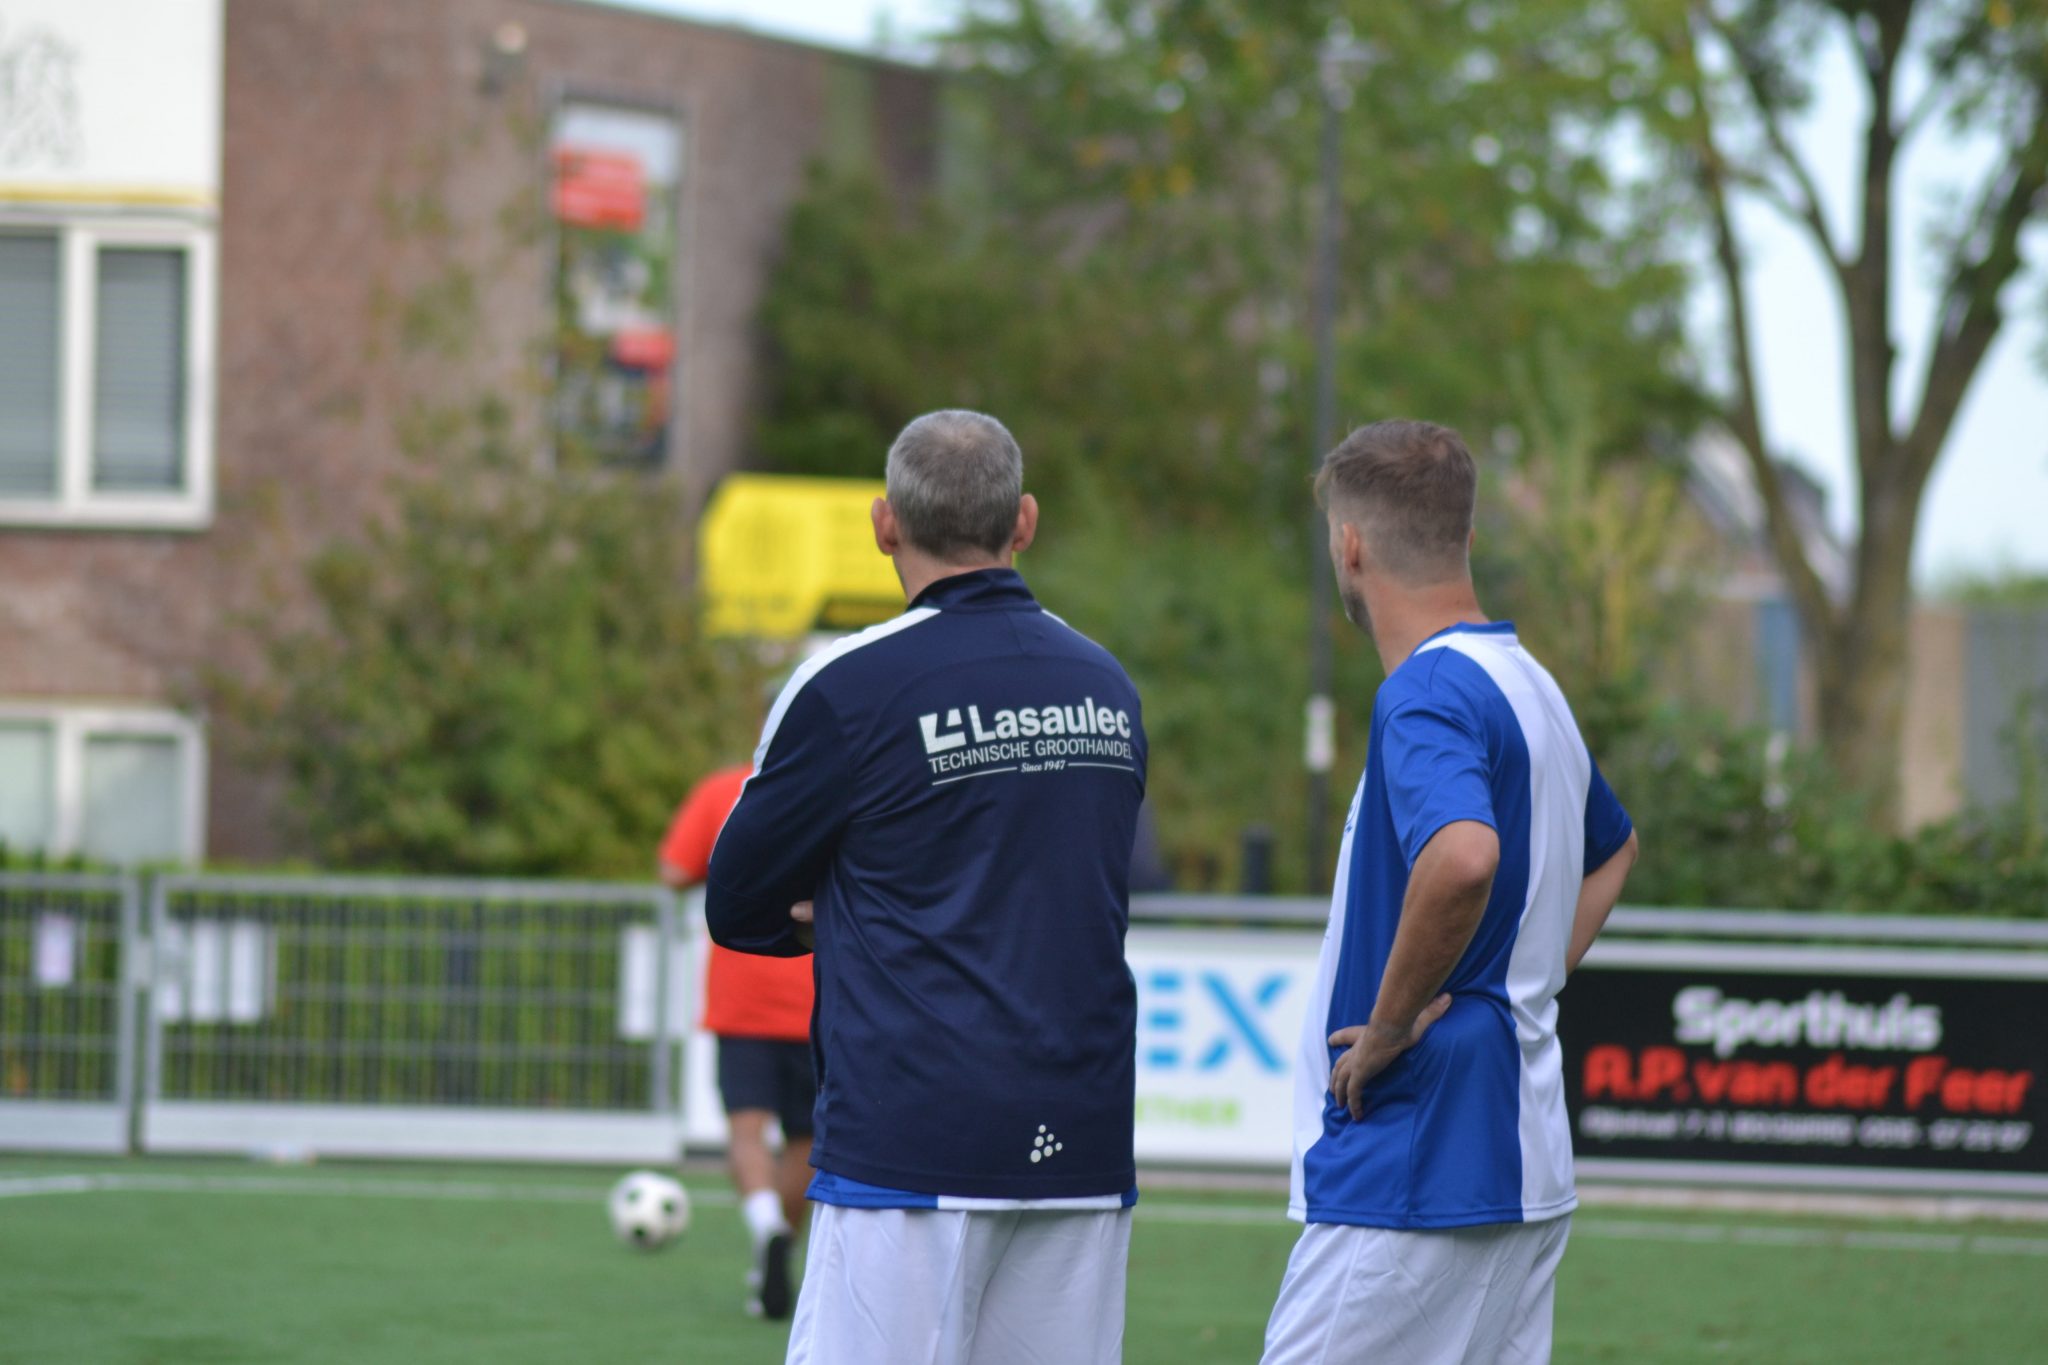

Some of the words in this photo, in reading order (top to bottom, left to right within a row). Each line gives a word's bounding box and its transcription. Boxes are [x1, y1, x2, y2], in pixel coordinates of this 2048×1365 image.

[968, 697, 1131, 743] Lasaulec
[928, 741, 1030, 774] TECHNISCHE
[1035, 738, 1133, 760] GROOTHANDEL
[1021, 762, 1042, 773] Since
[1044, 760, 1066, 771] 1947
[1673, 985, 1942, 1057] Sporthuis
[1693, 1060, 1798, 1105] van
[1804, 1053, 1896, 1109] der
